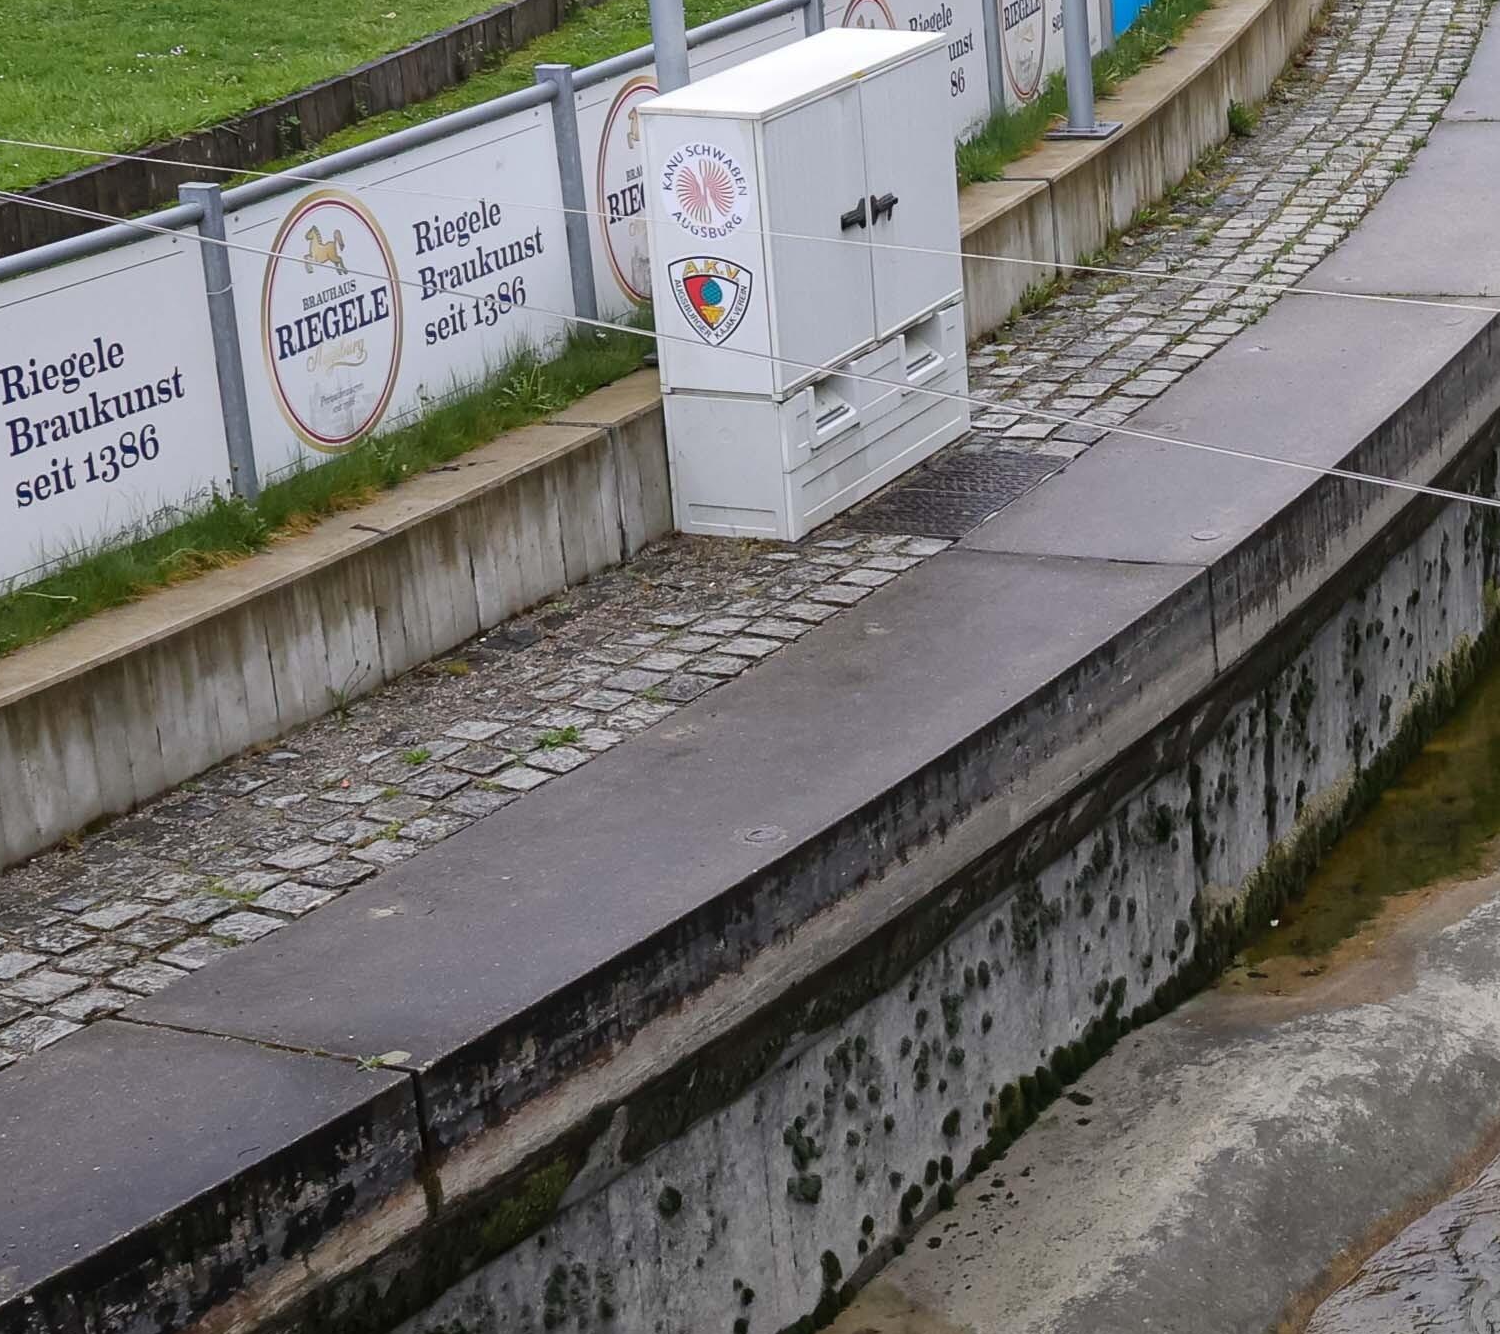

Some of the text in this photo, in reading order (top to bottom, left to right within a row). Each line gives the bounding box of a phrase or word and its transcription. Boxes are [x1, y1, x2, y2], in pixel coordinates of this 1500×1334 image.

[663, 144, 748, 196] KANU SCHWABEN
[412, 198, 501, 256] Riegele
[671, 211, 742, 239] AUGSBURG
[302, 279, 357, 311] BRAUHAUS
[418, 225, 545, 301] Braukunst
[275, 285, 390, 361] RIEGELE
[425, 276, 526, 347] seit 1386
[674, 279, 712, 339] AUGSBURGER
[5, 366, 185, 456] Braukunst
[15, 424, 160, 508] seit 1386
